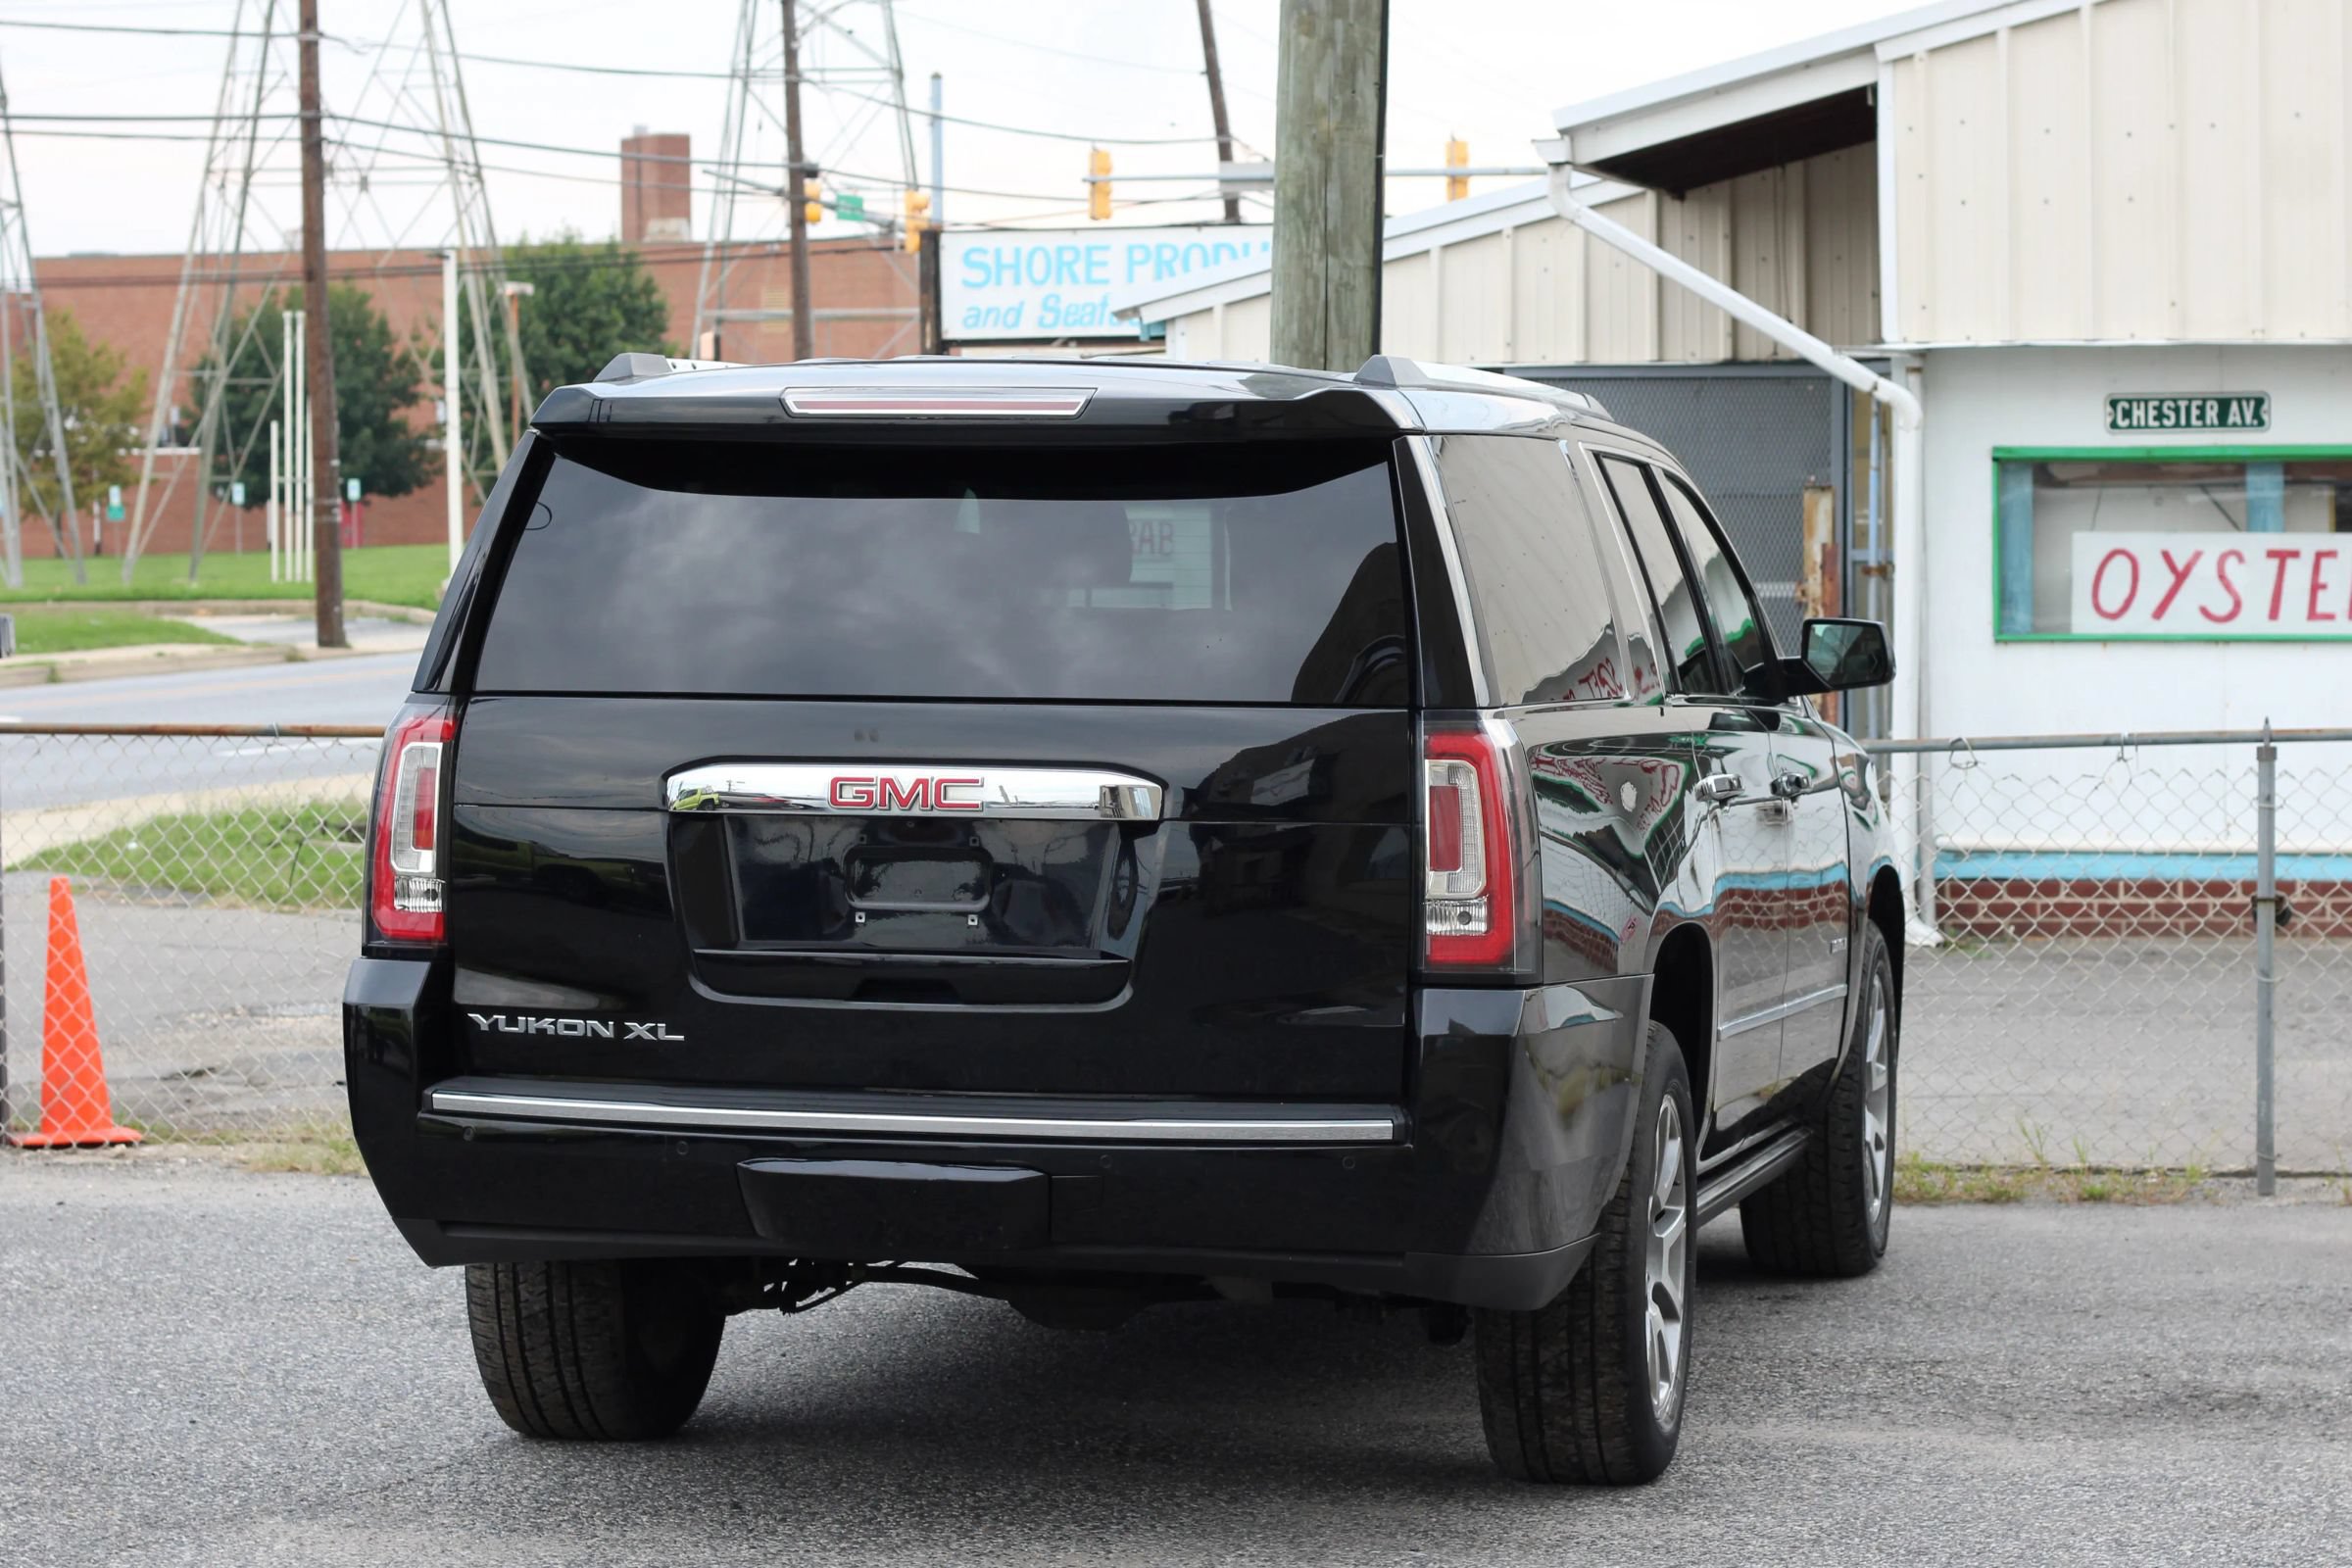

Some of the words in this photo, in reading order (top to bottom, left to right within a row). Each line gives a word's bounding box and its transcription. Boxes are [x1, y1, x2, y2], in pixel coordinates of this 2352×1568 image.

[961, 245, 1111, 288] SHORE
[963, 300, 1025, 329] and
[2116, 400, 2219, 428] CHESTER
[2228, 399, 2258, 426] AV.
[2091, 549, 2352, 623] OYSTE
[829, 775, 984, 811] GMC
[466, 1012, 614, 1039] YUKON
[623, 1021, 685, 1042] XL
